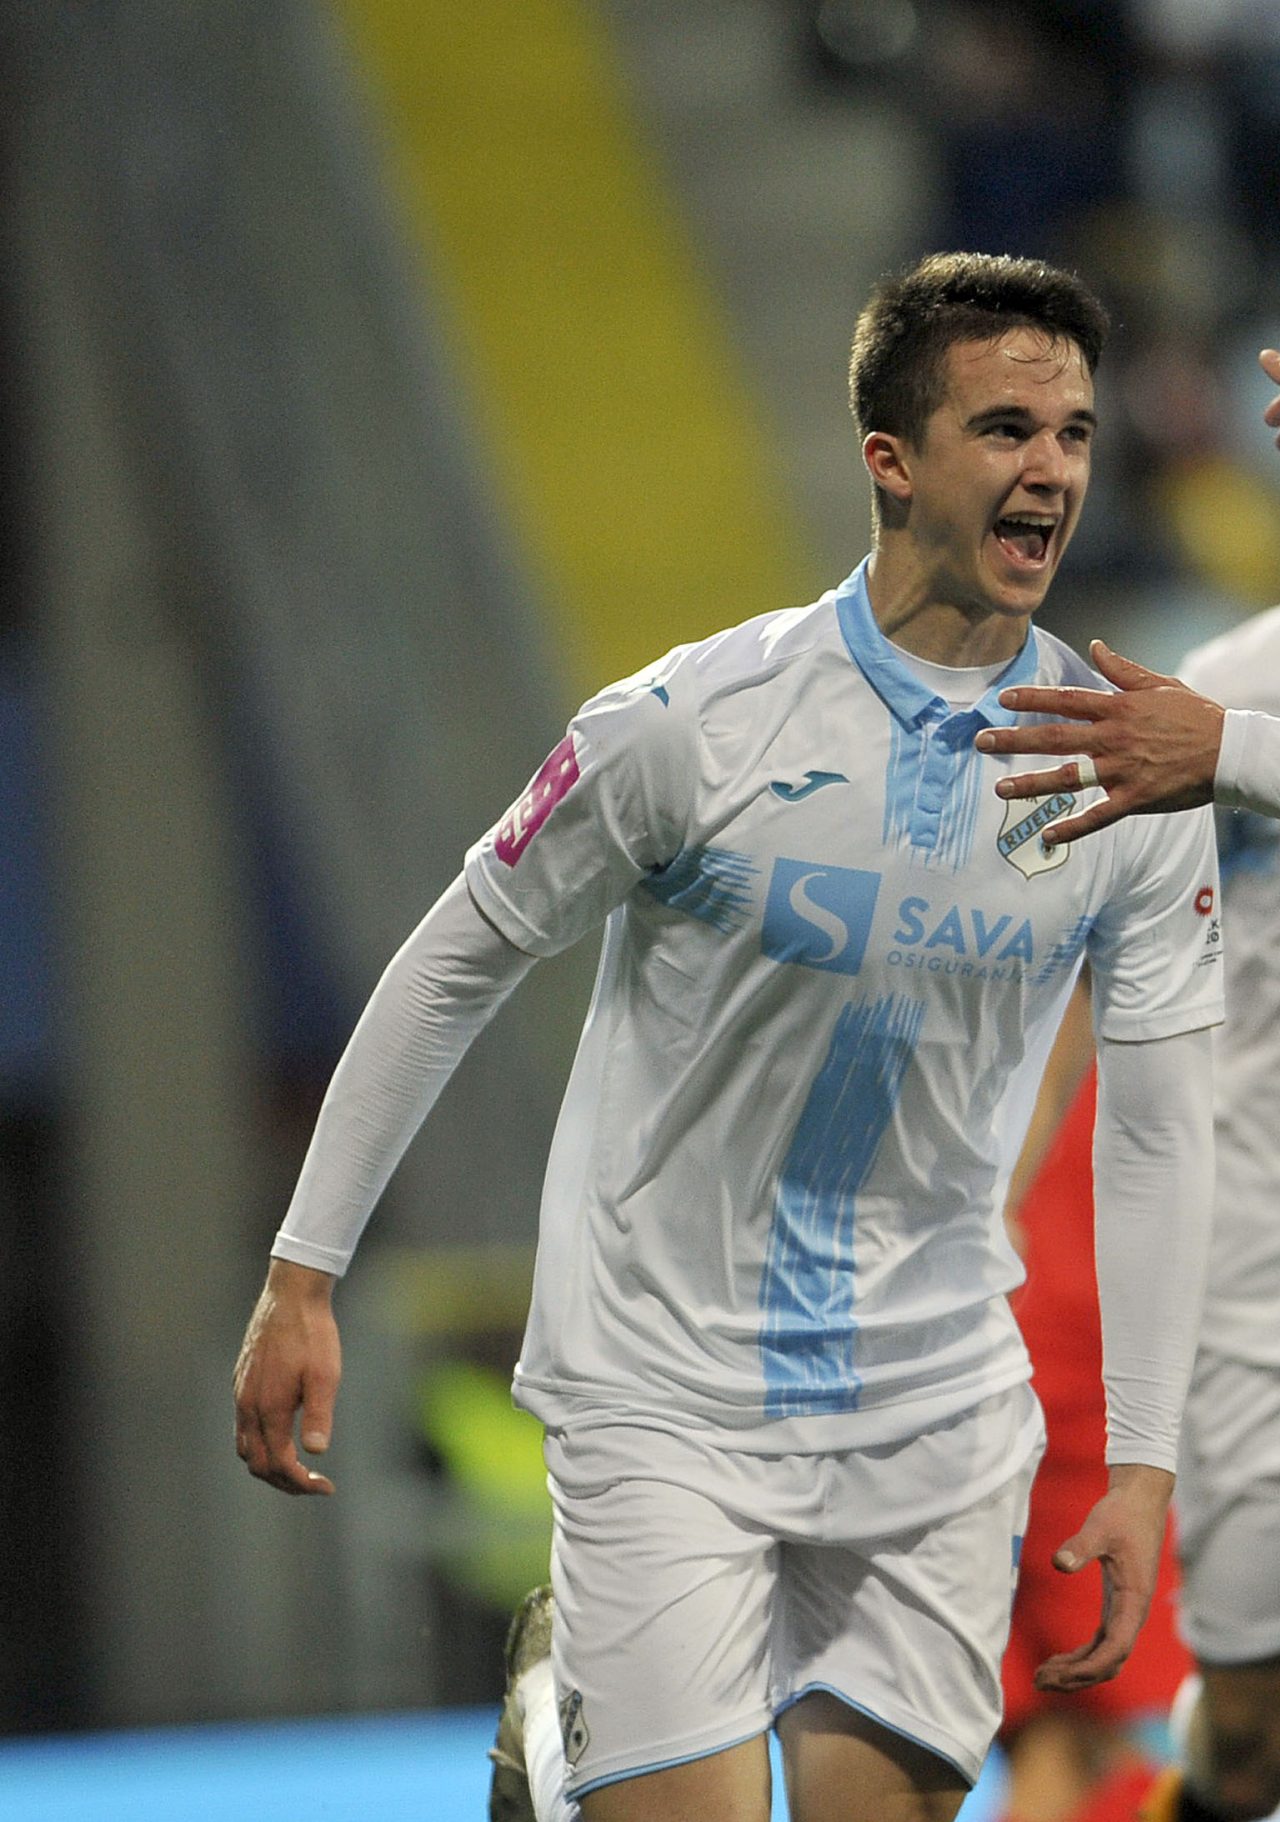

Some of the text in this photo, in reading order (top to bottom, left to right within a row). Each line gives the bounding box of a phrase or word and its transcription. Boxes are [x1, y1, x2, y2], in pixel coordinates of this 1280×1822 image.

[1004, 794, 1068, 850] RIJEKA
[894, 896, 1033, 964] SAVA
[887, 950, 1022, 984] OSIGURANJ
